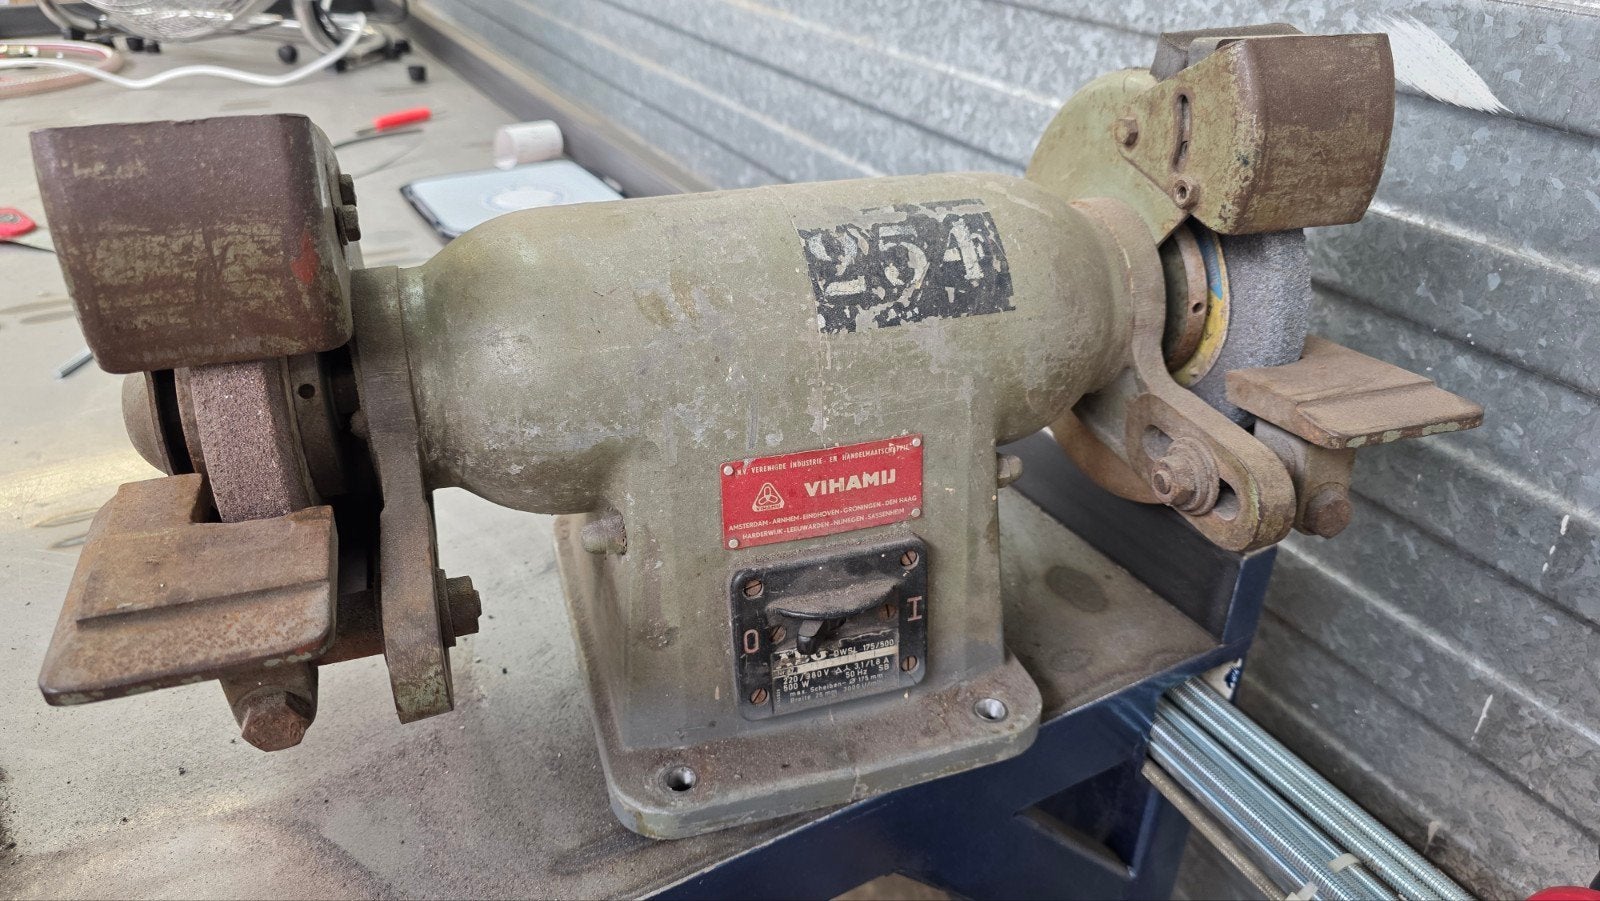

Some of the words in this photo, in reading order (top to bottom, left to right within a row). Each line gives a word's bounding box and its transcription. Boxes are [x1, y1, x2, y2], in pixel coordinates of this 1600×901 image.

[808, 218, 985, 298] 254
[751, 462, 786, 474] VERENIGDE
[829, 454, 838, 463] EN
[804, 468, 896, 497] VIHAMIJ
[728, 520, 769, 532] AMSTERDAM
[772, 514, 800, 525] ARNHEM
[802, 508, 840, 520] EINDHOVEN
[843, 501, 880, 513] GRONINGEN
[885, 498, 898, 506] DEN
[899, 494, 917, 504] HAAG
[742, 528, 783, 540] HARDERWIJK
[786, 521, 830, 533] LEEUWARDEN
[833, 514, 864, 526] NIJMEGEN
[867, 508, 905, 520] SASSENHEIM
[862, 638, 894, 651] 175/500
[846, 670, 854, 678] 50
